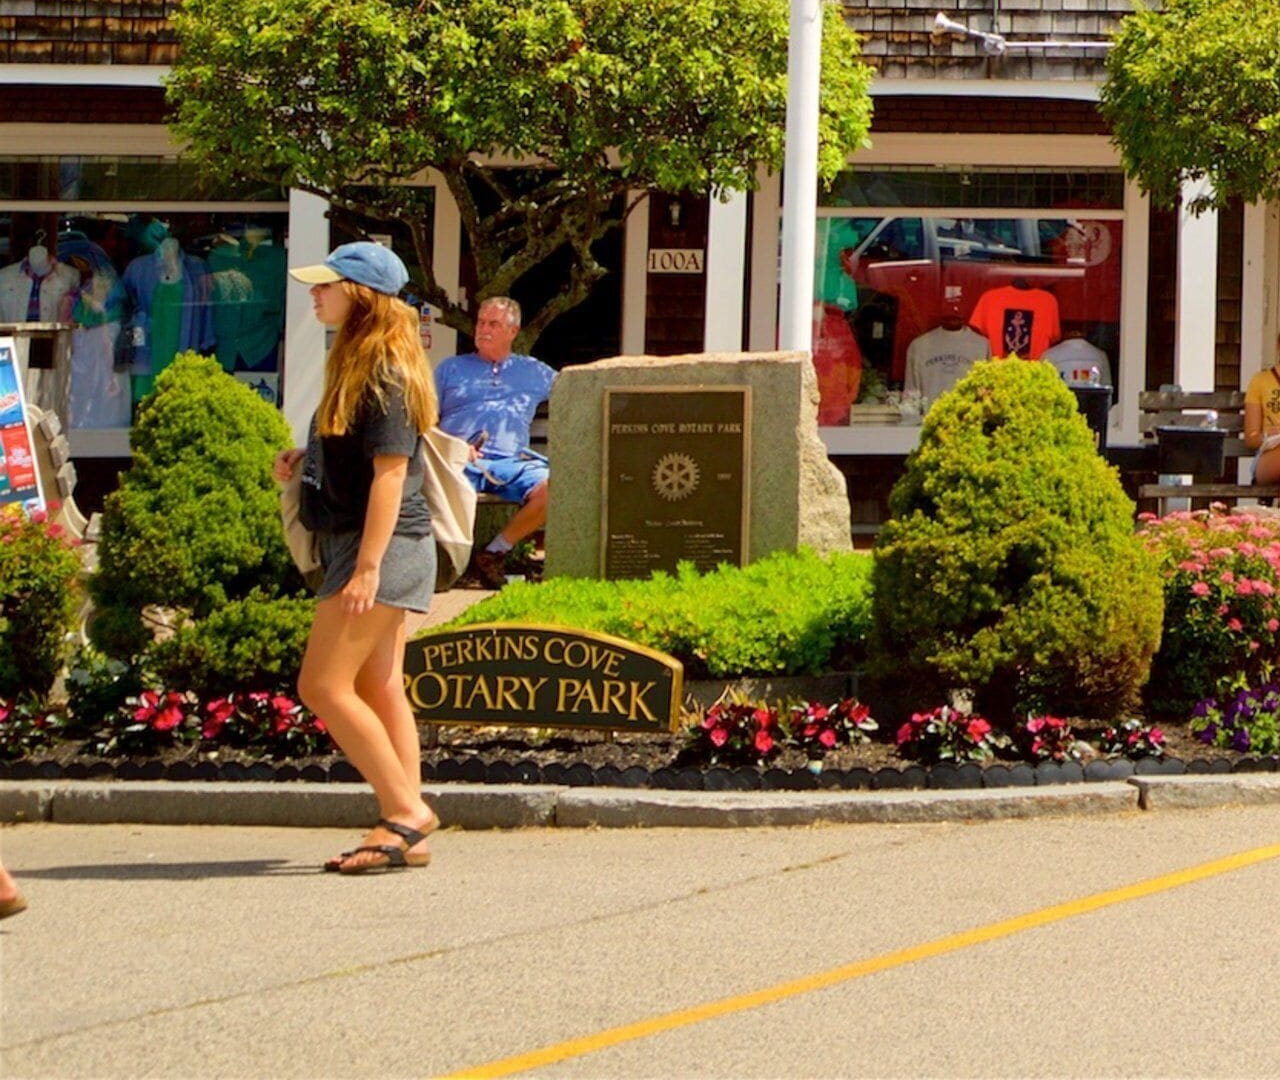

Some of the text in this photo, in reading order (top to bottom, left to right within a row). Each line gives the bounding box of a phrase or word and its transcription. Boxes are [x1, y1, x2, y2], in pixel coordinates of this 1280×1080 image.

[651, 251, 700, 270] 100A
[651, 423, 677, 434] COVE
[717, 423, 742, 434] PARK
[423, 635, 626, 678] PERKINS COVE
[555, 677, 659, 721] PARK
